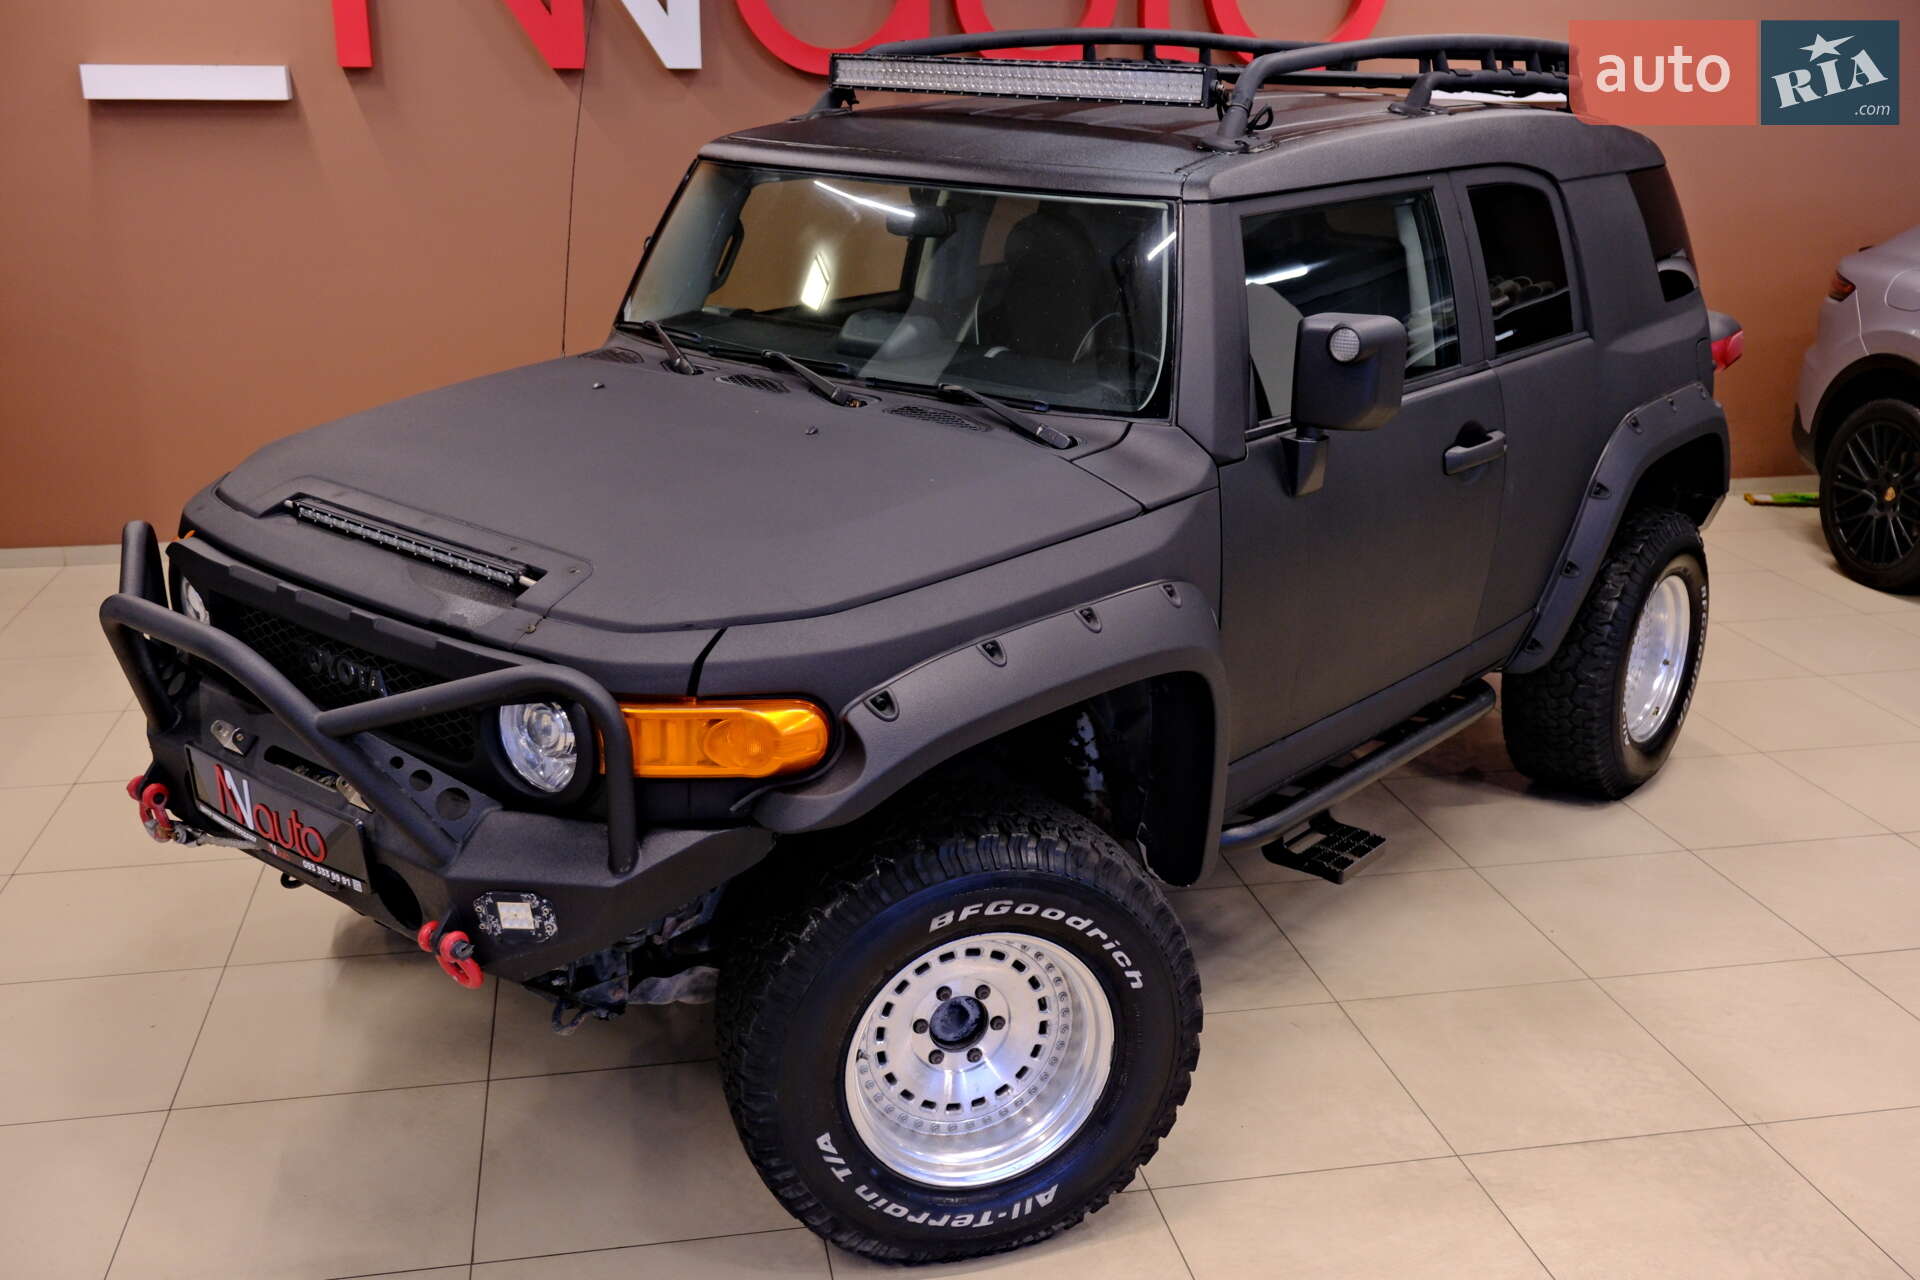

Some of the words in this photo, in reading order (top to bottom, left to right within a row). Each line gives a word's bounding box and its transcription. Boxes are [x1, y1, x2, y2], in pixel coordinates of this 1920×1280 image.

[928, 899, 1144, 990] BFGoodrich
[815, 1131, 853, 1183] T/A
[855, 1183, 1059, 1228] All-Terrain
